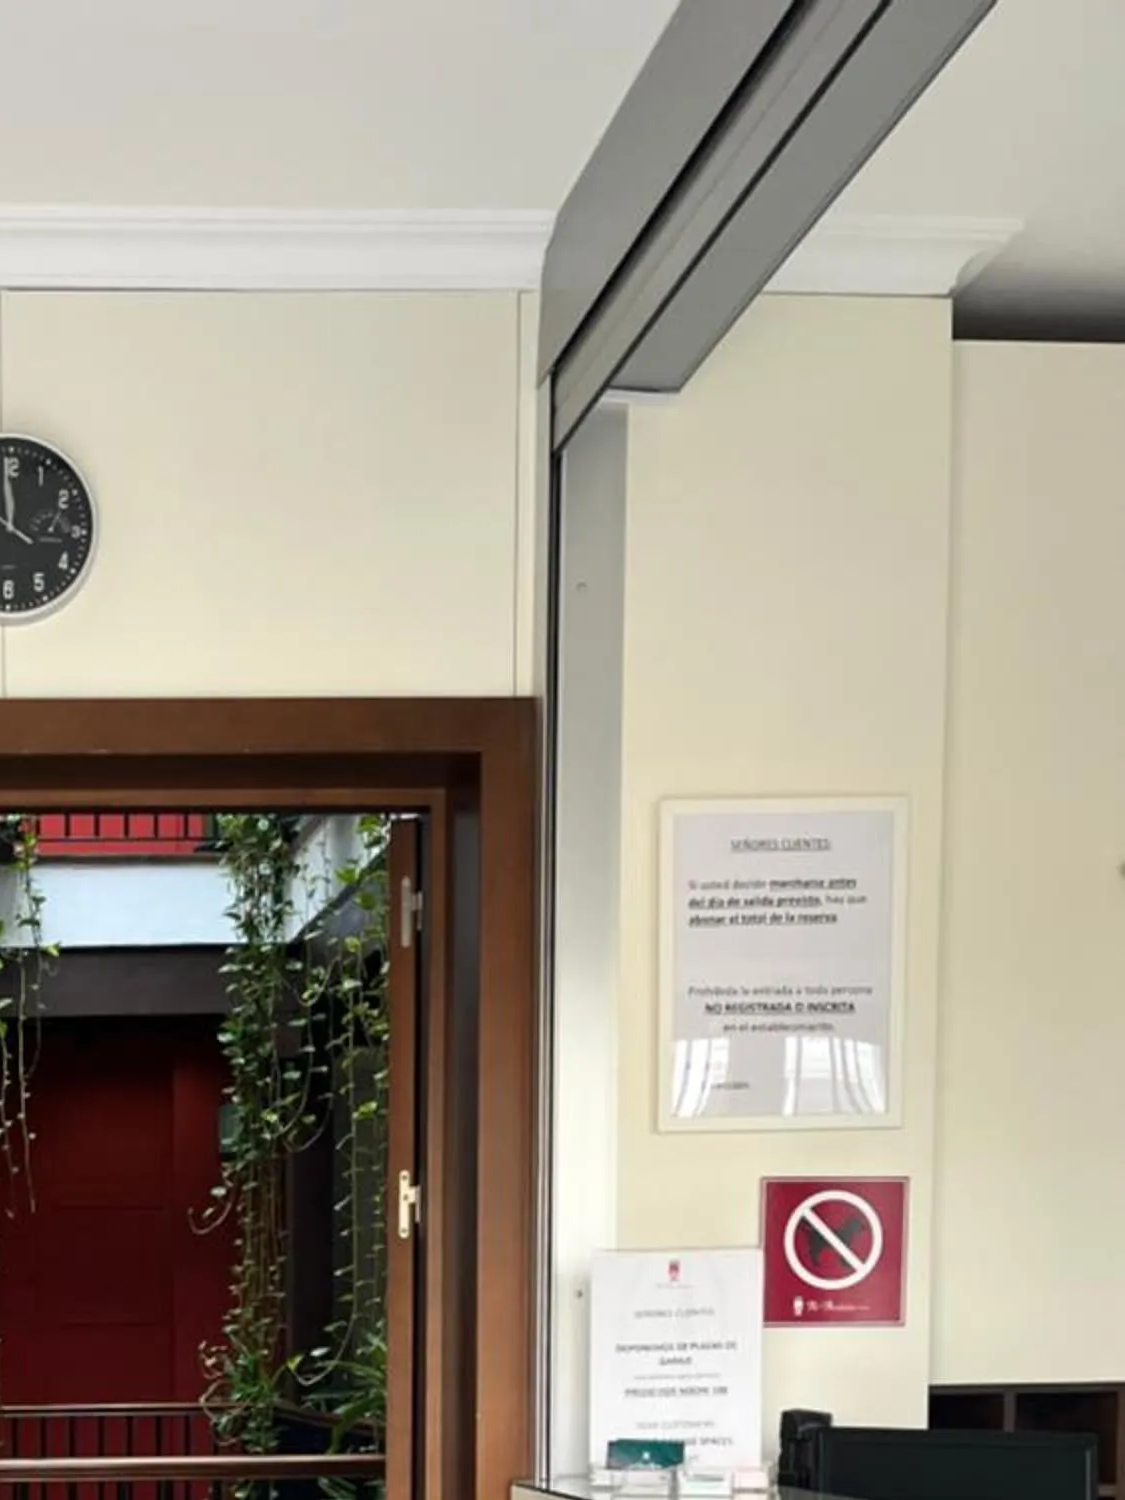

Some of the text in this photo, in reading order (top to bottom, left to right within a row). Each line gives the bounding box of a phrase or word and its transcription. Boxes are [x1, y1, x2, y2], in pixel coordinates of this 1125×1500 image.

[3, 458, 20, 478] 12
[38, 466, 44, 487] 1
[58, 489, 69, 509] 2
[71, 525, 81, 538] 3
[58, 551, 68, 569] 4
[3, 580, 14, 599] 6
[33, 572, 45, 592] 5
[730, 838, 779, 853] SEÑORES
[700, 880, 730, 890] usted
[733, 879, 766, 890] decide
[769, 879, 824, 891] marcharse
[828, 878, 857, 890] antes
[688, 896, 706, 909] del
[727, 896, 741, 908] de
[743, 895, 775, 908] salida
[825, 895, 844, 906] hay
[847, 895, 868, 906] que
[688, 914, 726, 927] abonar
[729, 914, 738, 926] el
[741, 913, 767, 926] total
[769, 913, 783, 926] de
[785, 913, 795, 925] la
[752, 985, 793, 996] entrada
[831, 986, 873, 997] persona
[705, 1001, 856, 1015] NO REGISTRADA O INSCRITA
